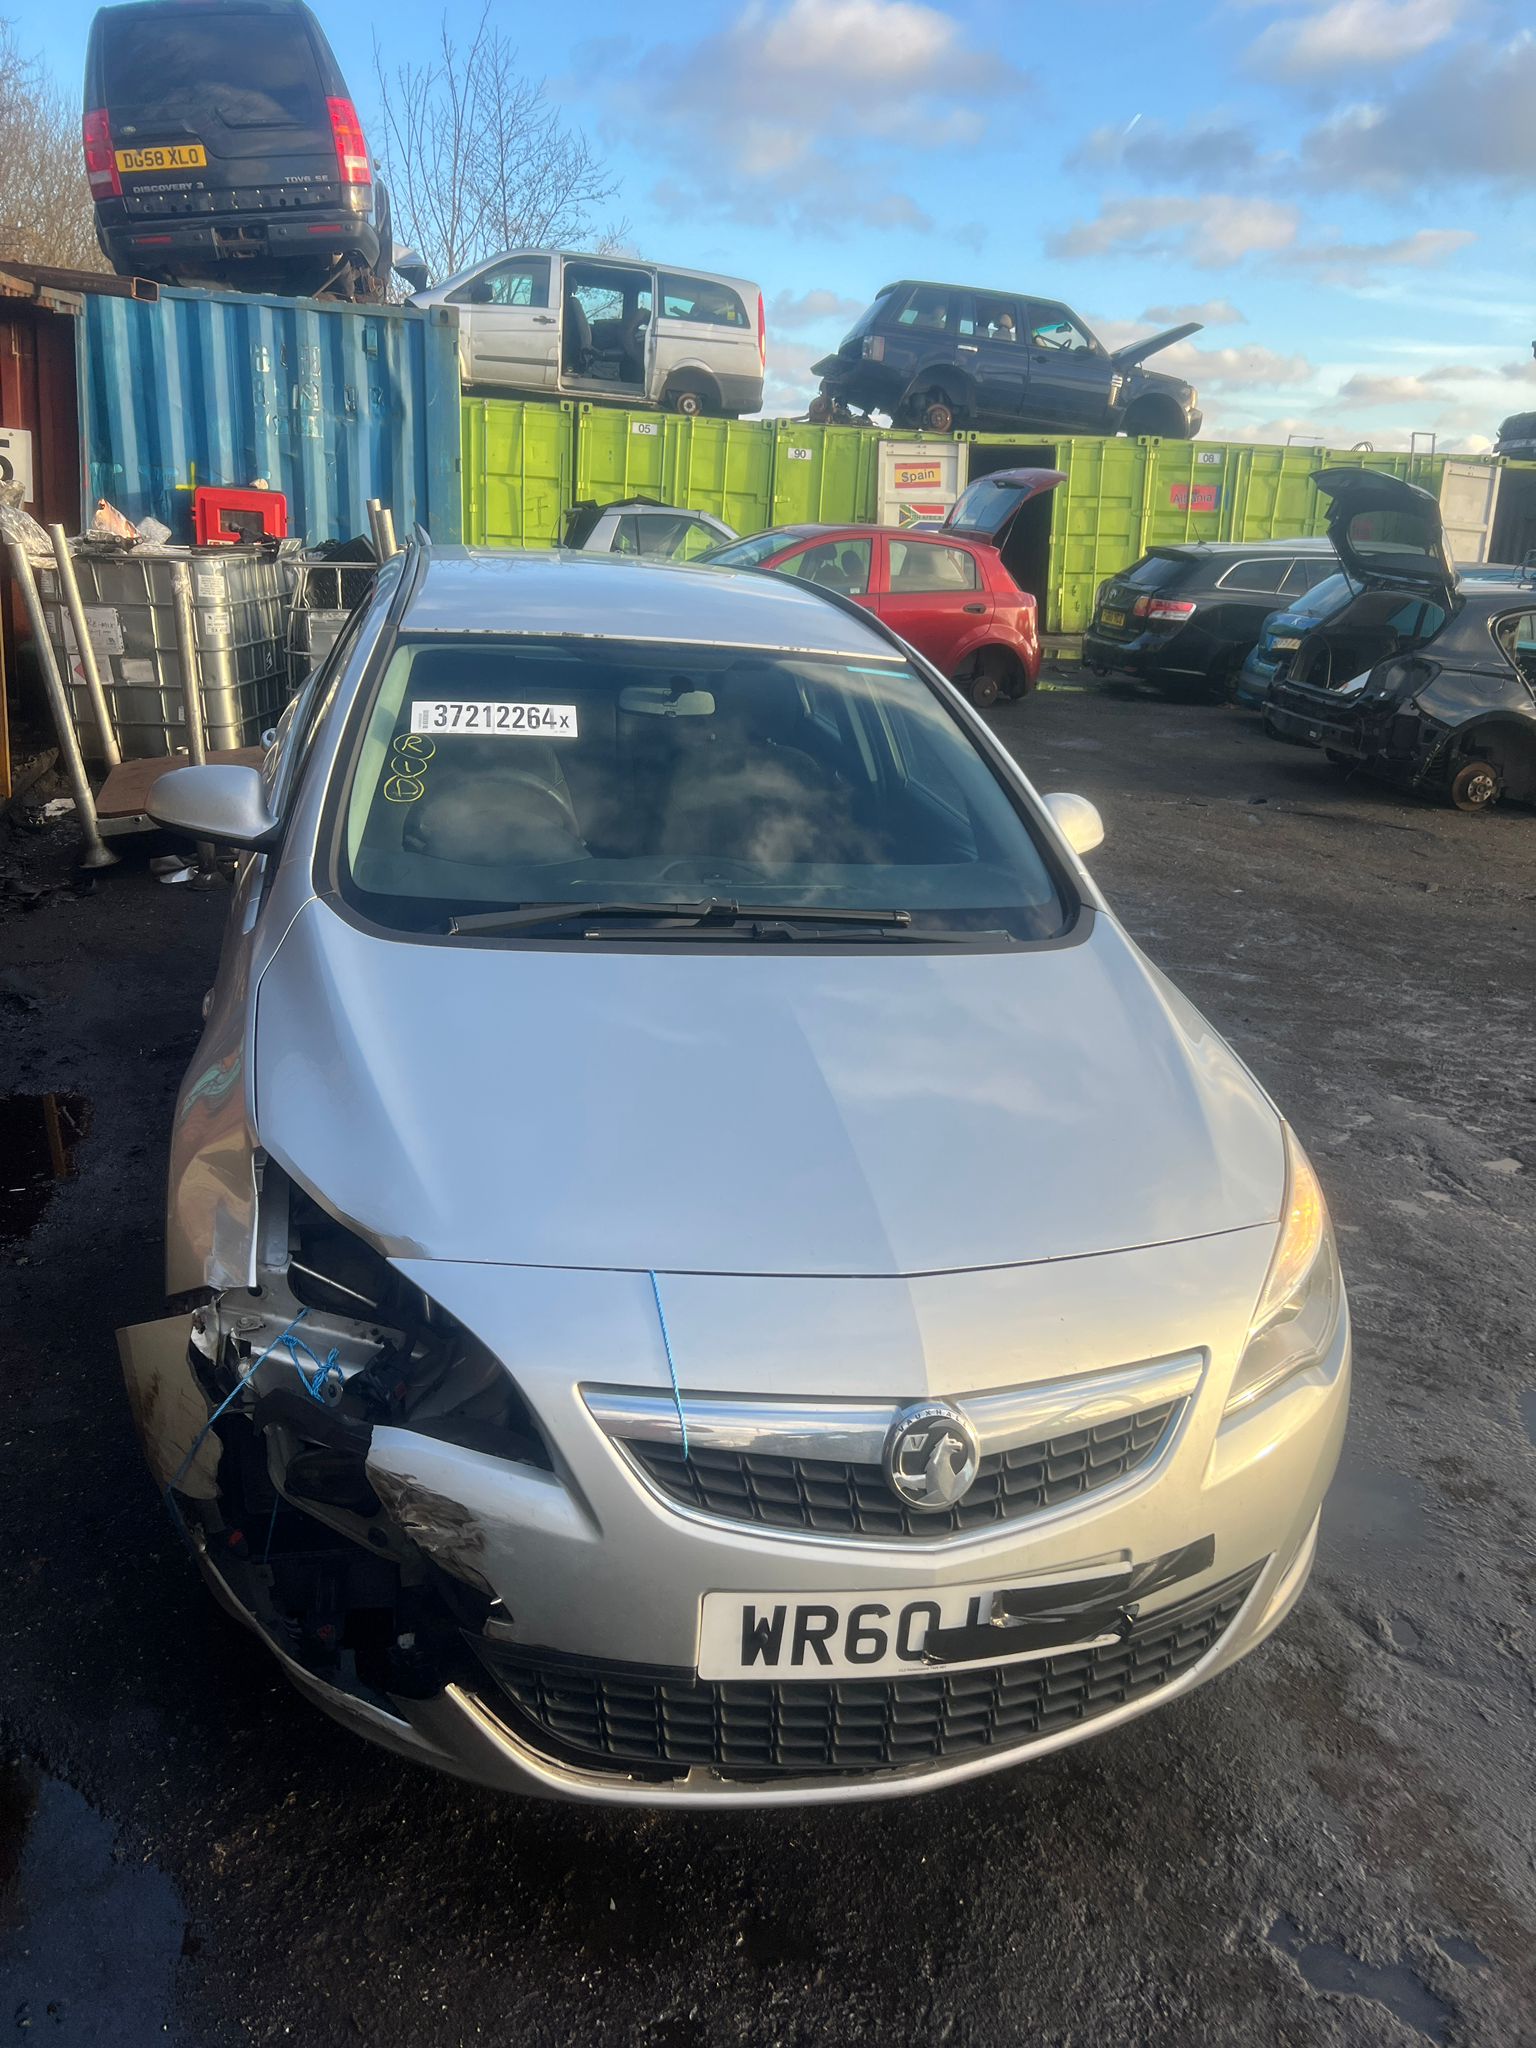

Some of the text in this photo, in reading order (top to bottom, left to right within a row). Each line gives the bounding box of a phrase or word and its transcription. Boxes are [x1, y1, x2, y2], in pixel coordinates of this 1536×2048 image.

[123, 148, 199, 169] DG58 XLO
[284, 174, 329, 184] TDV6 SE
[133, 181, 205, 194] DISCOVERY 3
[638, 423, 651, 434] 05
[794, 448, 807, 459] 90
[901, 468, 935, 483] Spain
[401, 735, 423, 753] R
[396, 778, 419, 798] D
[897, 1409, 969, 1433] VAUXHALL
